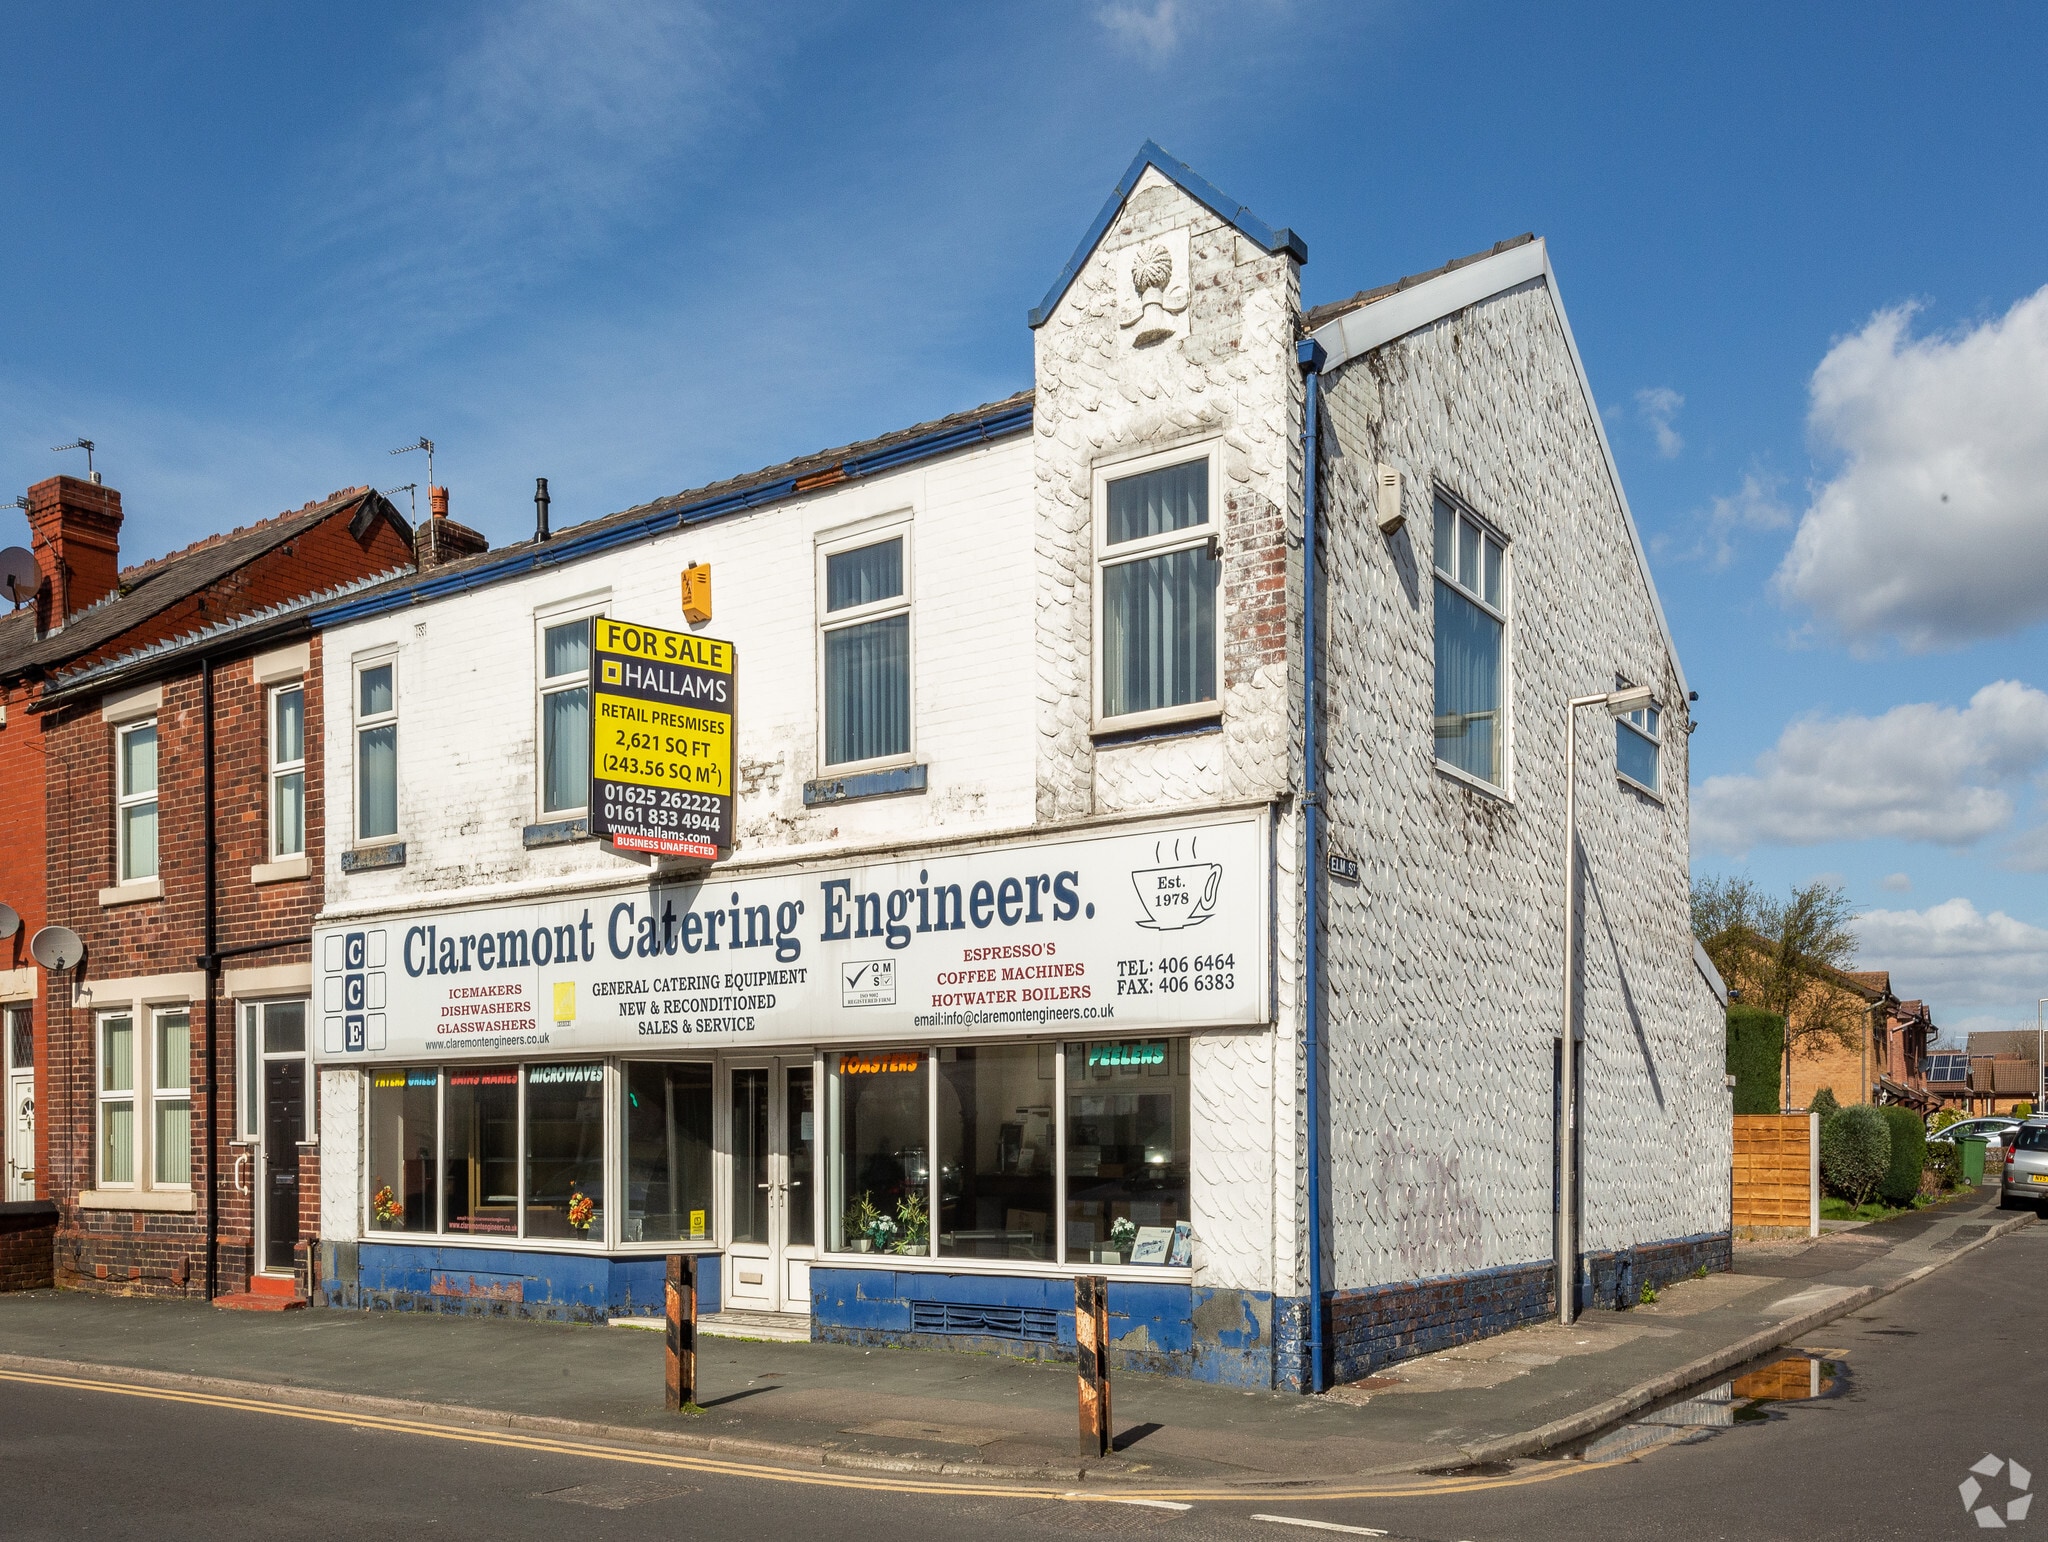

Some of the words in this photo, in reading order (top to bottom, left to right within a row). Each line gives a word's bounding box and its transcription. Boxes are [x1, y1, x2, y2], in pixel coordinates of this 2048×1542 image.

[608, 624, 658, 657] FOR
[664, 636, 722, 668] SALE
[625, 663, 727, 703] HALLAMS
[601, 702, 648, 723] RETAIL
[651, 709, 725, 735] PRESMISES
[616, 729, 660, 751] 2,621
[665, 737, 688, 757] SQ
[692, 741, 710, 758] FT
[603, 753, 664, 778] (243.56
[669, 762, 691, 783] SQ
[604, 783, 657, 806] 01625
[660, 791, 721, 814] 262222
[604, 803, 643, 823] 0161
[648, 808, 678, 827] 833
[681, 813, 721, 832] 4944
[607, 823, 711, 844] www.hallams.com
[617, 836, 659, 851] BUSINESS
[660, 840, 715, 856] UNAFFECTED
[1331, 857, 1345, 873] ELM
[1157, 874, 1187, 891] Est.
[1155, 891, 1190, 908] 1978
[403, 908, 595, 978] Claremont
[607, 892, 805, 963] Catering
[820, 869, 1096, 950] Engineers.
[349, 939, 362, 965] C
[963, 942, 1056, 962] ESPRESSO'S
[872, 962, 879, 972] Q
[883, 962, 891, 973] M
[937, 968, 997, 986] COFFEE
[1001, 962, 1085, 982] MACHINES
[1117, 958, 1153, 977] TEL:
[1158, 956, 1189, 974] 406
[1194, 952, 1236, 973] 6464
[349, 979, 361, 1005] C
[449, 984, 523, 1000] ICEMAKERS
[592, 979, 650, 997] GENERAL
[653, 974, 720, 993] CATERING
[724, 968, 808, 990] EQUIPMENT
[873, 976, 880, 986] S
[1117, 978, 1153, 996] FAX:
[1158, 975, 1189, 993] 406
[1194, 973, 1235, 991] 6383
[619, 1001, 646, 1017] NEW
[650, 1000, 660, 1015] &
[663, 994, 776, 1014] RECONDITIONED
[931, 989, 1017, 1008] HOTWATER
[1021, 985, 1091, 1002] BOILERS
[441, 1001, 531, 1017] DISHWASHERS
[914, 1003, 1115, 1027] email:info@claremontengineers.co.uk
[349, 1021, 362, 1047] E
[437, 1018, 536, 1035] GLASSWASHERS
[638, 1020, 678, 1035] SALES
[682, 1019, 692, 1033] &
[696, 1016, 755, 1033] SERVICE
[425, 1032, 550, 1050] www.claremontengineers.co.uk
[839, 1053, 918, 1075] TOASTERS
[1088, 1042, 1165, 1067] PEELERS
[529, 1065, 604, 1083] MICROWAVES
